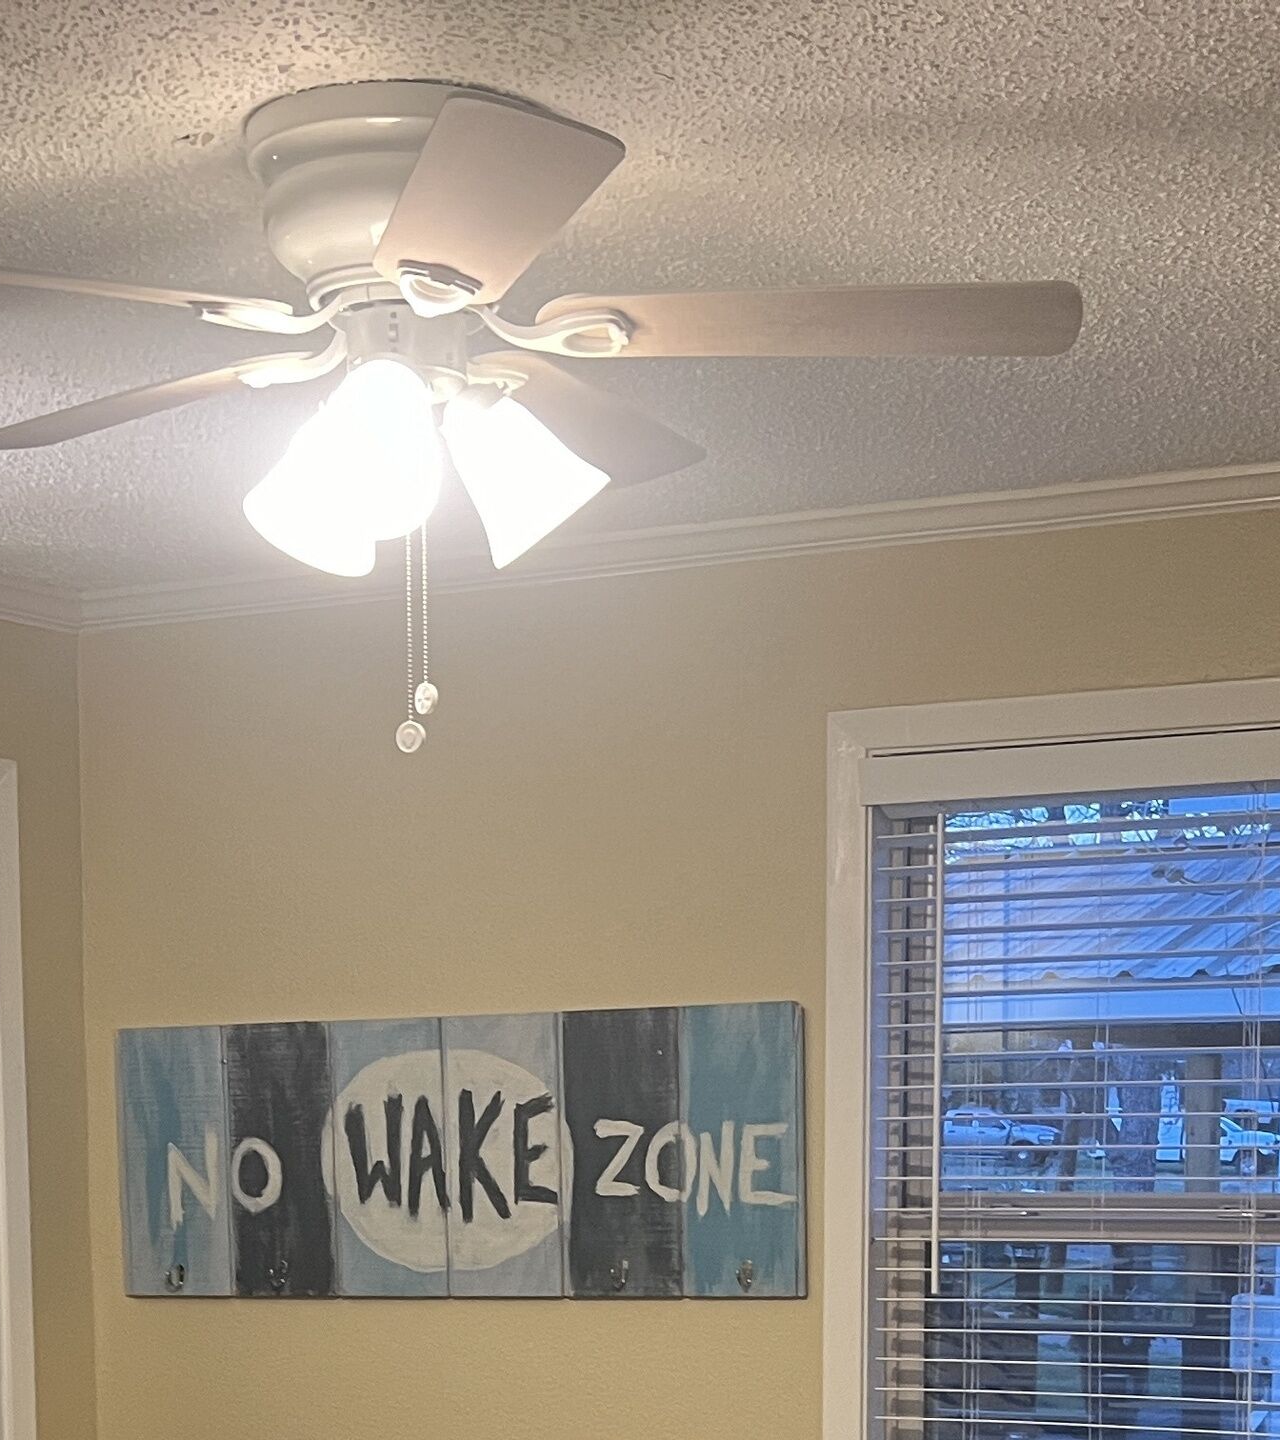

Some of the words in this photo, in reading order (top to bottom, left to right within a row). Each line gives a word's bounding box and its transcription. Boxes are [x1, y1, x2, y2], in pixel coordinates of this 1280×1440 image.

[167, 1123, 283, 1230] NO
[344, 1088, 558, 1223] WAKE
[594, 1119, 800, 1216] ZONE
